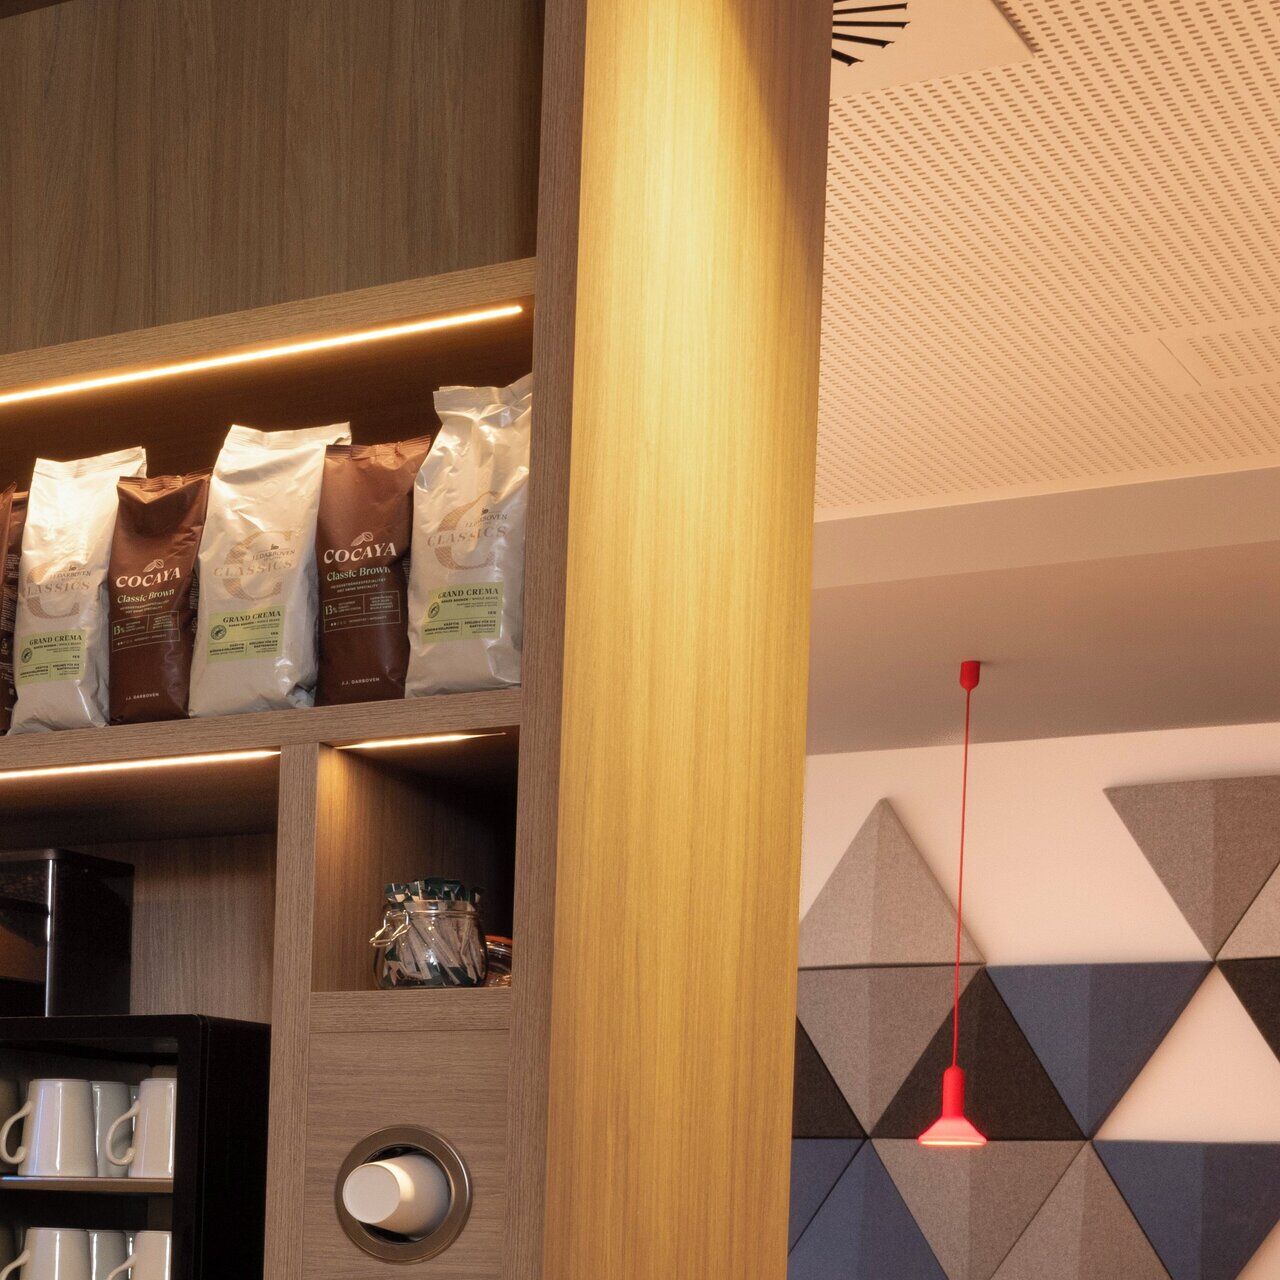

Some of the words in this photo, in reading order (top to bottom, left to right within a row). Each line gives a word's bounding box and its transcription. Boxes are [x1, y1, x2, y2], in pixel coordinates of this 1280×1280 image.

[323, 542, 397, 564] COCAYA
[213, 561, 292, 577] CLASSICS
[326, 569, 357, 582] Classic
[359, 566, 391, 577] Brown
[115, 567, 181, 588] COCAYA
[23, 581, 90, 597] LASSICS
[117, 594, 147, 604] Classic
[148, 588, 175, 600] Brown
[438, 589, 465, 599] GRAND
[466, 588, 499, 596] CREMA
[223, 614, 251, 623] GRAND
[252, 610, 281, 619] CREMA
[29, 636, 53, 646] GRAND
[54, 634, 82, 642] CREMA
[351, 677, 380, 685] DARBOVEN
